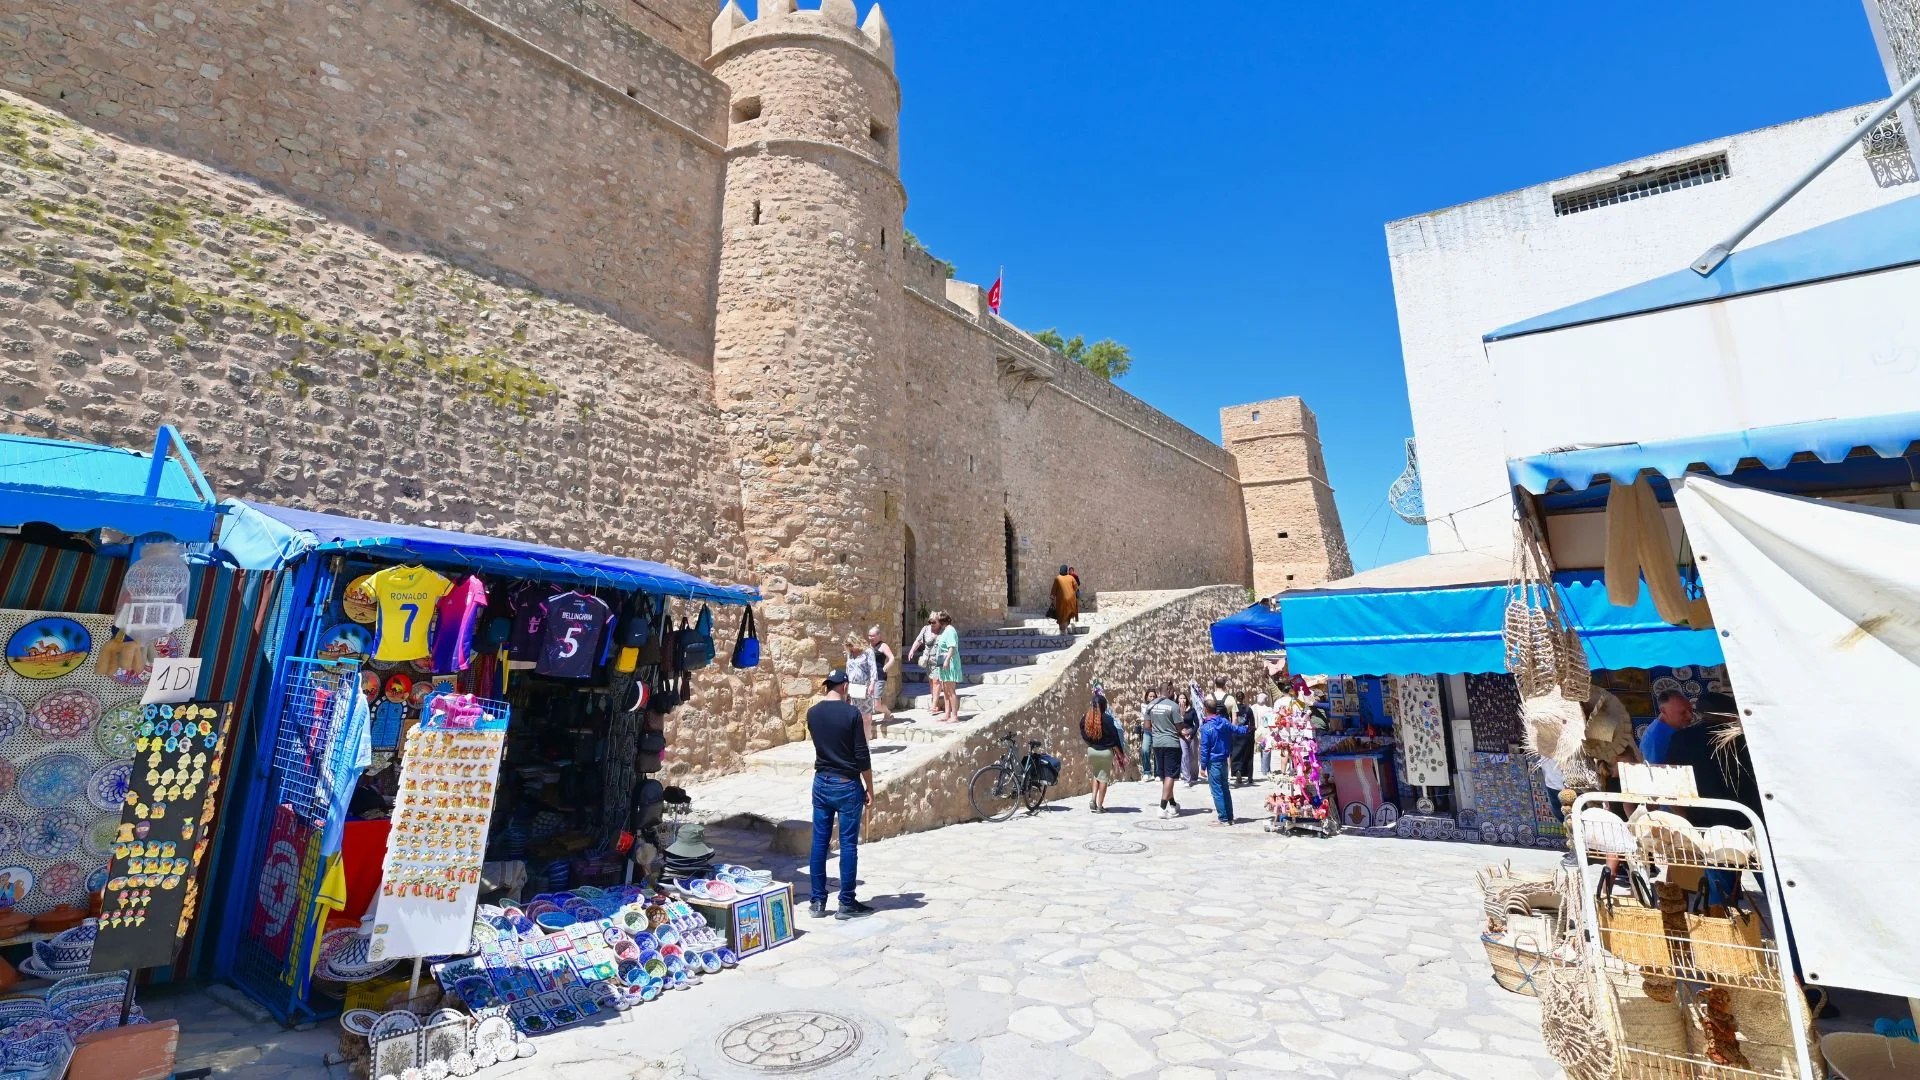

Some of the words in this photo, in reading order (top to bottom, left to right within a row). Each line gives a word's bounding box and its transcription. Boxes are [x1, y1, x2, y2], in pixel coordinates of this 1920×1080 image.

[390, 592, 428, 600] RONALDO
[400, 603, 419, 643] 7
[558, 627, 582, 658] 5
